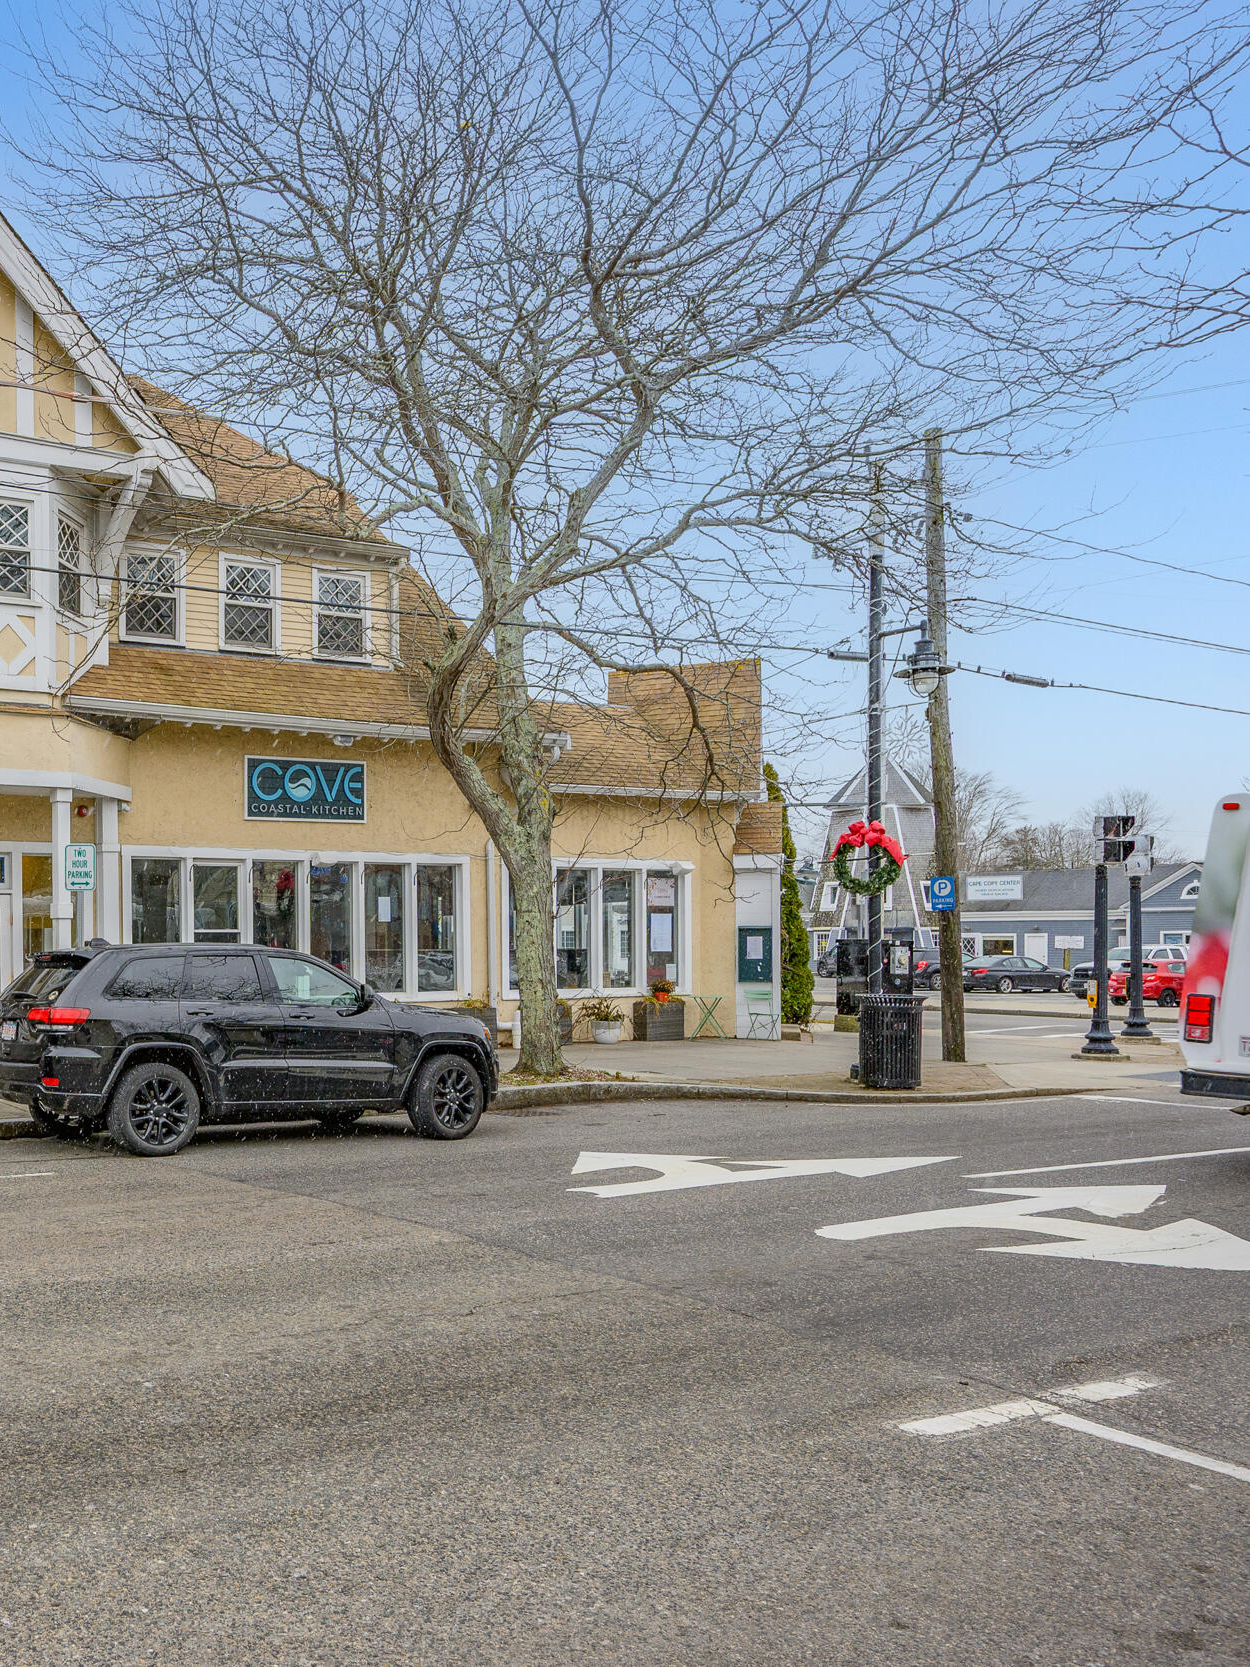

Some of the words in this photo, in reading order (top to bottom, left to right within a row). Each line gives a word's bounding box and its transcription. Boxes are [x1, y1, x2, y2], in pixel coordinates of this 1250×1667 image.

[251, 762, 362, 804] COVE
[74, 849, 87, 857] TWO
[71, 860, 88, 868] HOUR
[67, 871, 92, 879] PARKING
[938, 882, 948, 894] P
